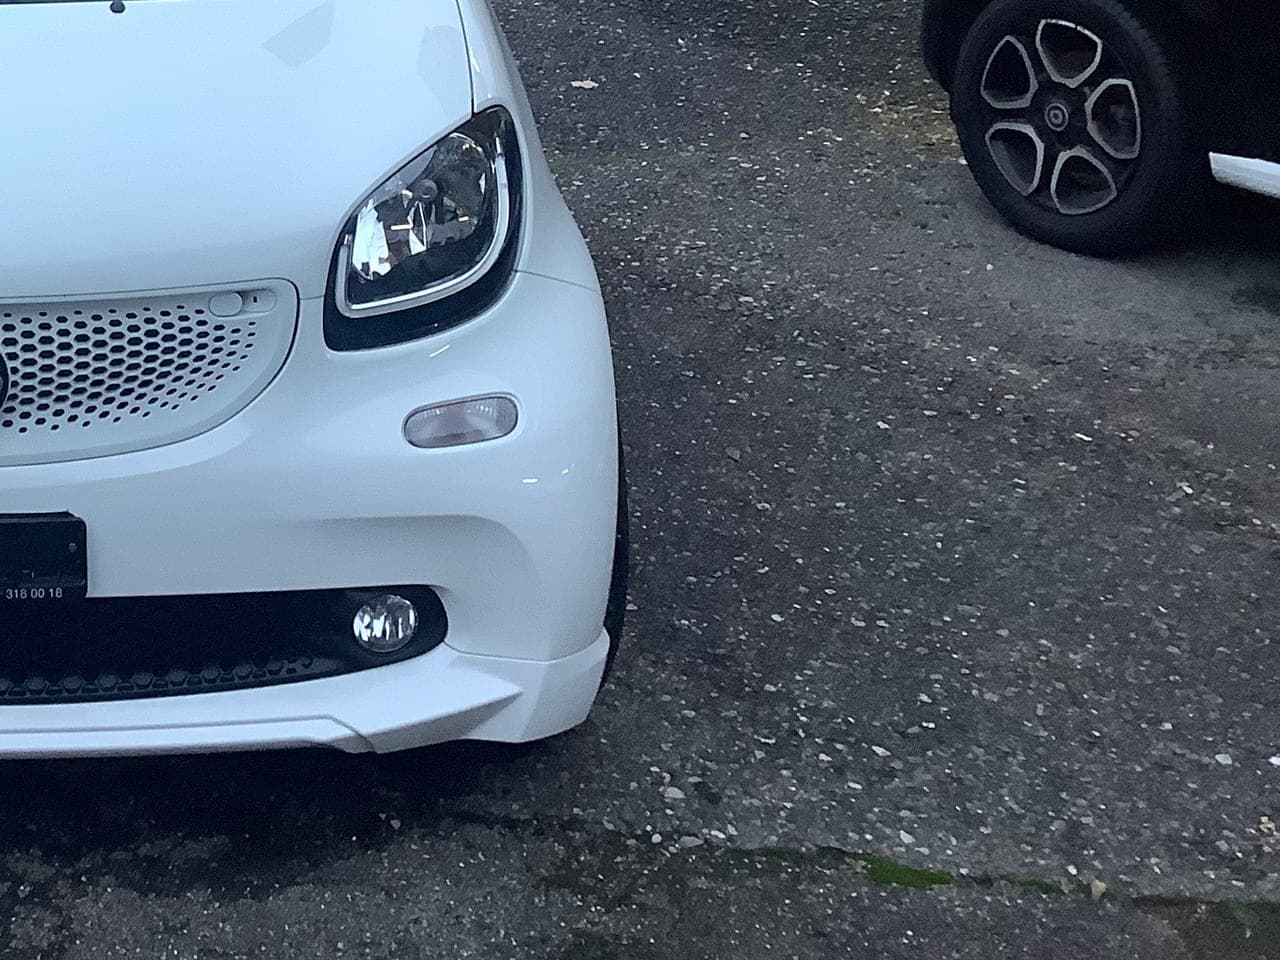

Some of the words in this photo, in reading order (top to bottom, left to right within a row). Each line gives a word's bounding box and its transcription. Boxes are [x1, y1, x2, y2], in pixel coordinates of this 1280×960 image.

[6, 588, 27, 600] 318
[30, 587, 45, 599] 00
[49, 587, 63, 599] 18
